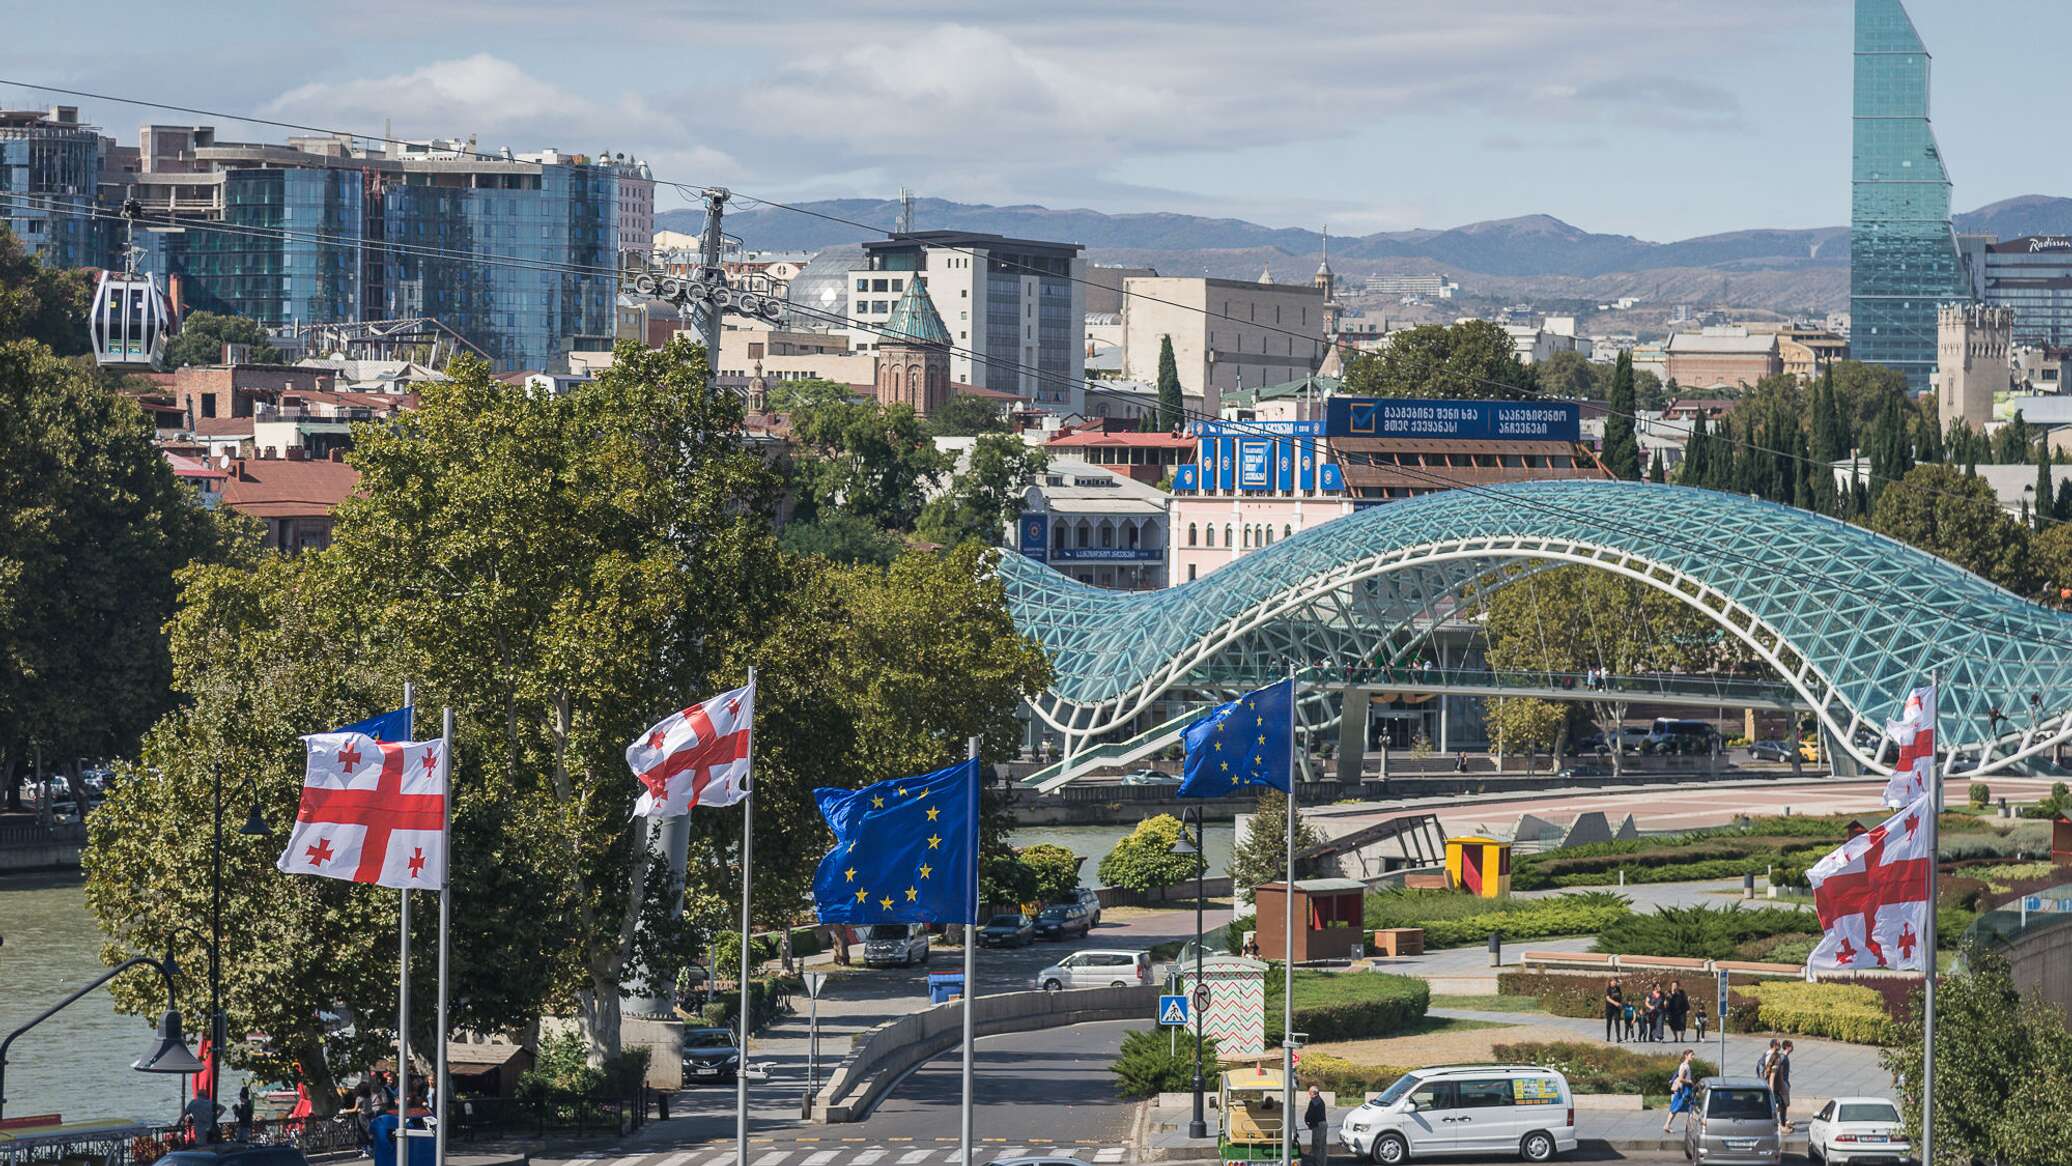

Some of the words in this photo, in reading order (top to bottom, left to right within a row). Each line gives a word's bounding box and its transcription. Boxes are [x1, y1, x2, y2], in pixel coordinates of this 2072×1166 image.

[2029, 235, 2071, 253] Radisson
[1436, 408, 1459, 420] შენი
[1461, 408, 1478, 420] ხმა
[1498, 409, 1567, 421] საპრეზიდენტო
[1498, 422, 1547, 434] არჩევნები
